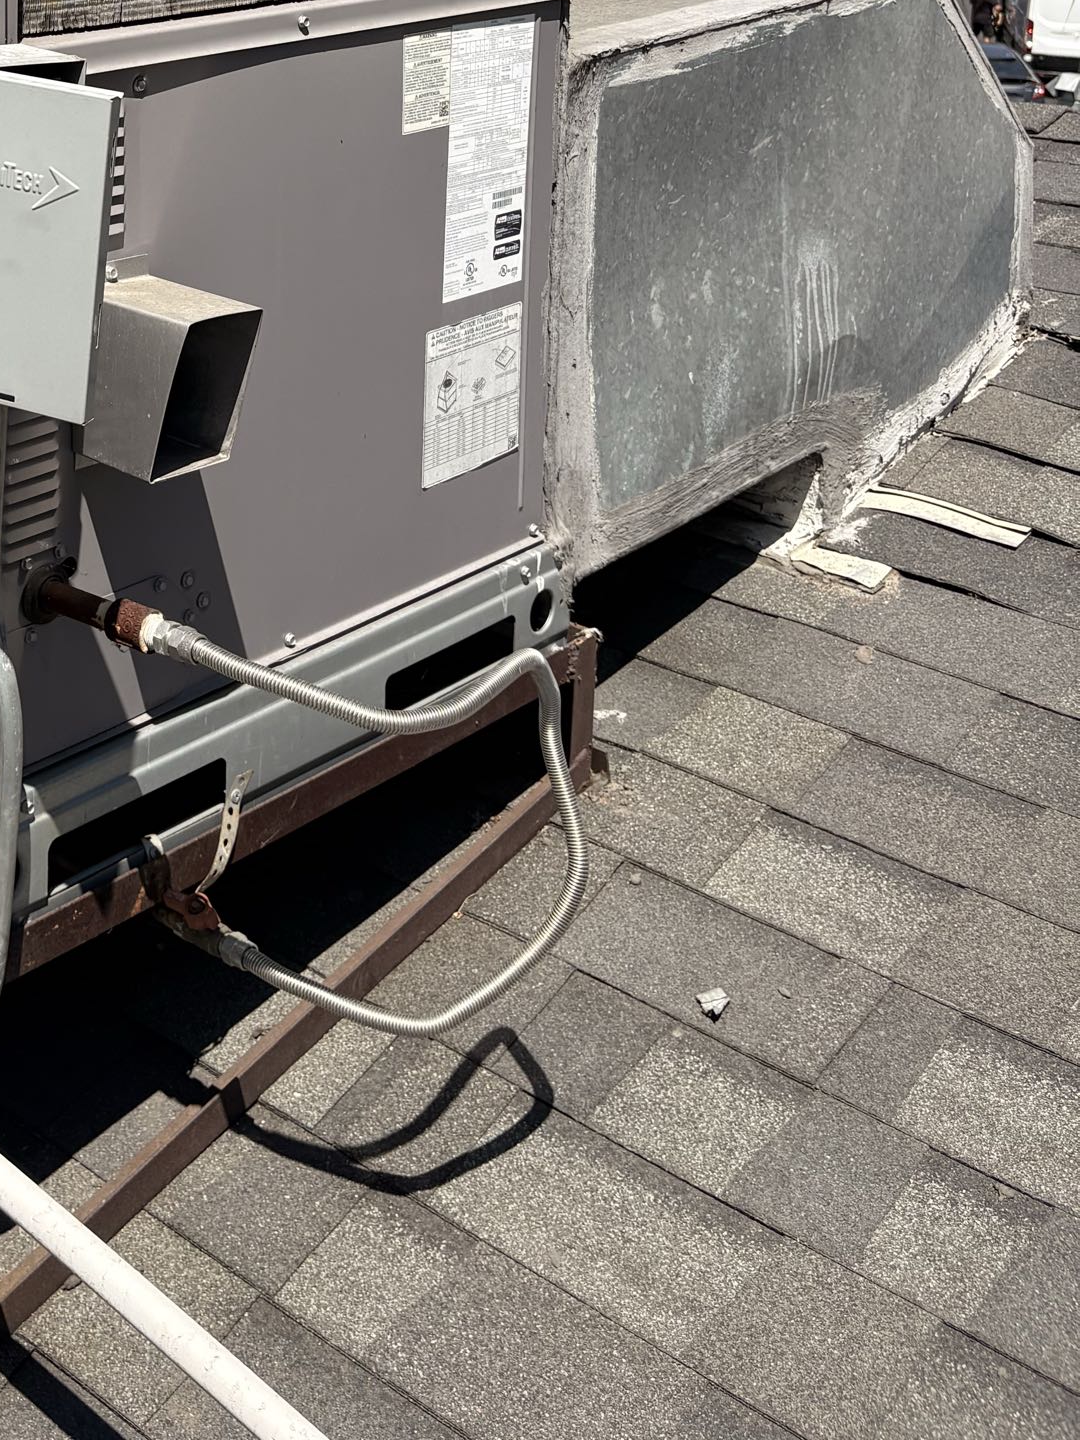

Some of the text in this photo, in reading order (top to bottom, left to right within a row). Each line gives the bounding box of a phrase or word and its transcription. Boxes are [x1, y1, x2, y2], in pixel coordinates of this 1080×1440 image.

[435, 326, 457, 339] CAUTION
[459, 320, 477, 331] NOTICE
[484, 311, 504, 323] RIGGERS
[435, 333, 461, 345] PRUDENCE
[463, 327, 475, 337] AVIS
